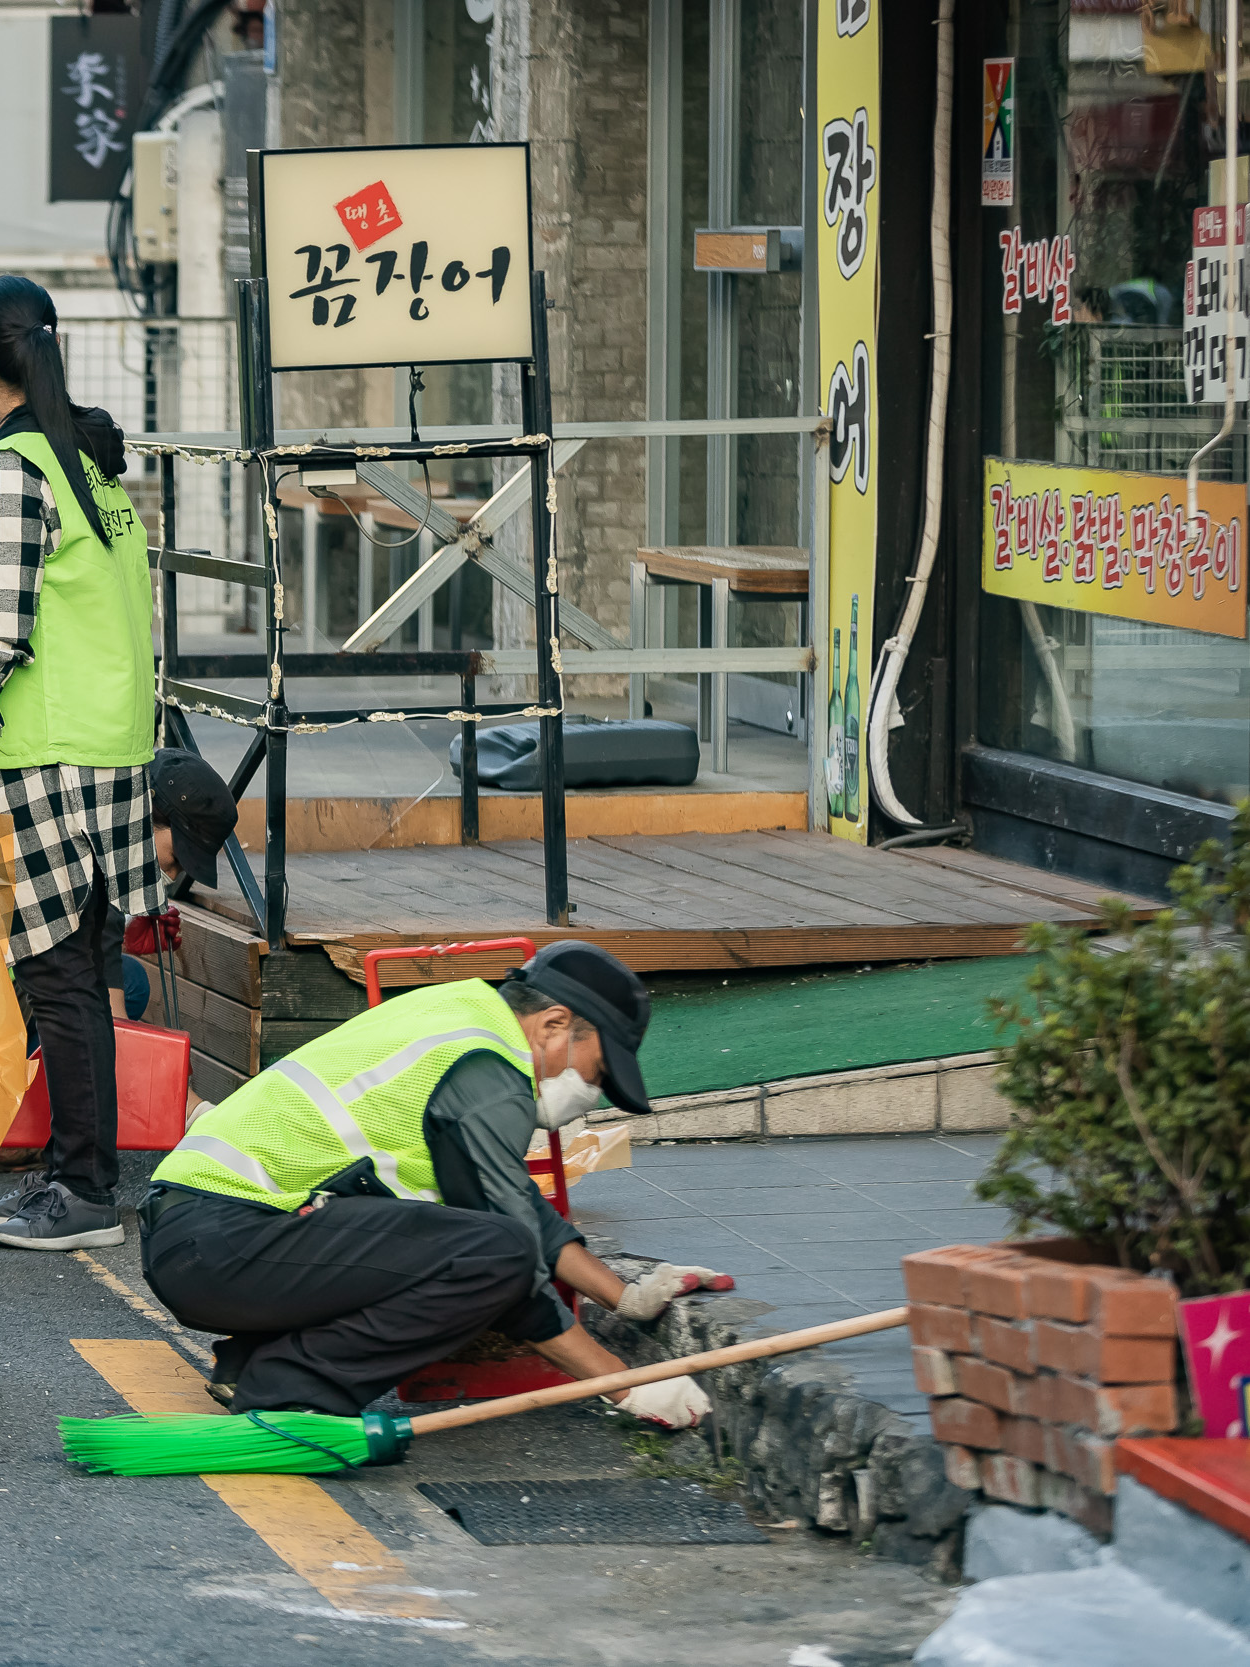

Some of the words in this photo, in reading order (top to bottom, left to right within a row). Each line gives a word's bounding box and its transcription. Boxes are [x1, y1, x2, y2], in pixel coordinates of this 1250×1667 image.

[343, 199, 397, 230] 땡초
[823, 0, 876, 494] 장어
[289, 241, 511, 328] 꼼장어
[998, 225, 1077, 326] 갈비살
